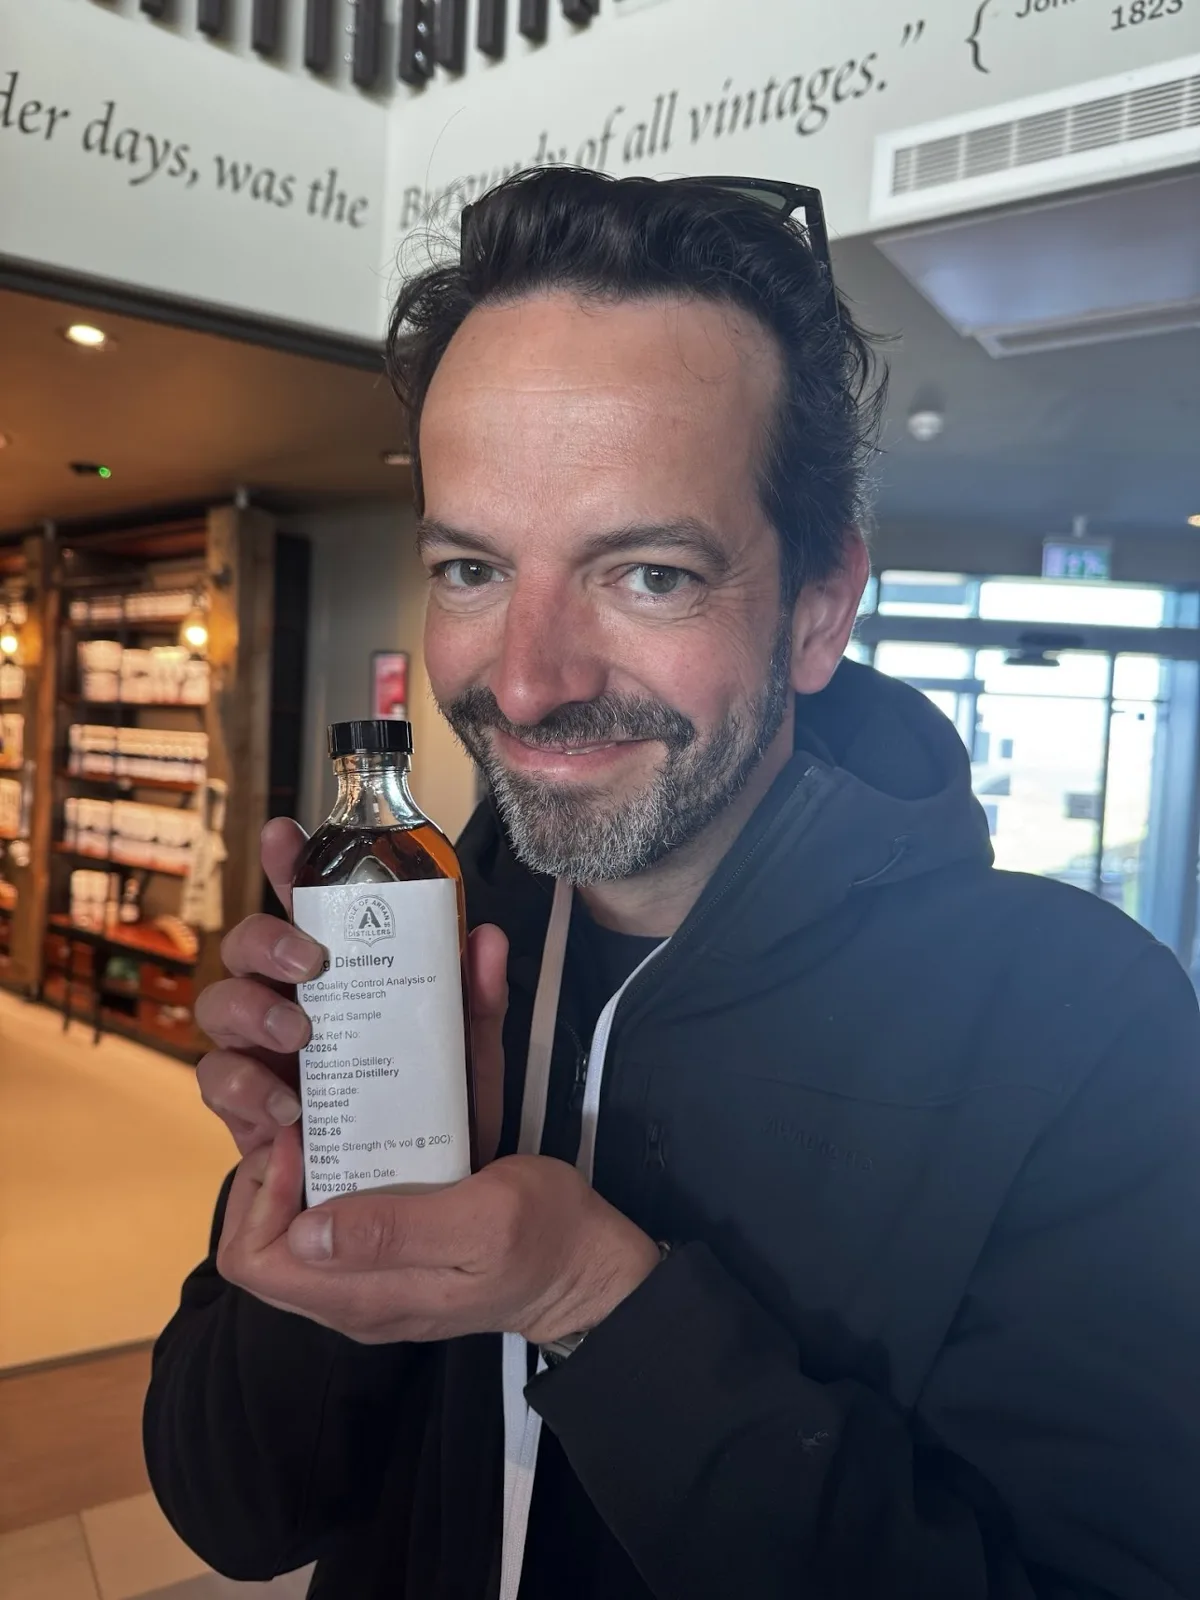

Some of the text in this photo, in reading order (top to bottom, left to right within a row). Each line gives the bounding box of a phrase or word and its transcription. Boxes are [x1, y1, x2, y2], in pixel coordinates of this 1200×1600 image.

[1110, 0, 1184, 31] 1823
[574, 105, 626, 173] of
[622, 90, 679, 164] all
[689, 52, 887, 136] vintages.
[82, 102, 200, 187] days,
[214, 154, 296, 210] was
[306, 168, 369, 229] the
[358, 898, 369, 907] OF
[348, 929, 391, 938] DISTILLERS
[335, 955, 395, 969] Distillery
[302, 974, 436, 991] For Quality Control Analysis or
[302, 989, 387, 1003] Scientific Research
[309, 1009, 382, 1025] uty Paid Sample
[326, 1031, 343, 1041] Ref
[344, 1030, 361, 1040] No:
[305, 1055, 395, 1069] Production Distillery:
[306, 1067, 400, 1081] Lochranza Distillery
[306, 1085, 360, 1097] Spirit Grade:
[307, 1098, 349, 1110] Unpeated
[308, 1113, 357, 1126] Sample No:
[308, 1126, 342, 1137] 2025-26
[309, 1134, 454, 1154] Sample Strength (% vol @ 20C):
[310, 1169, 341, 1181] Sample
[343, 1168, 371, 1179] Taken
[311, 1183, 358, 1193] 24/03/2025
